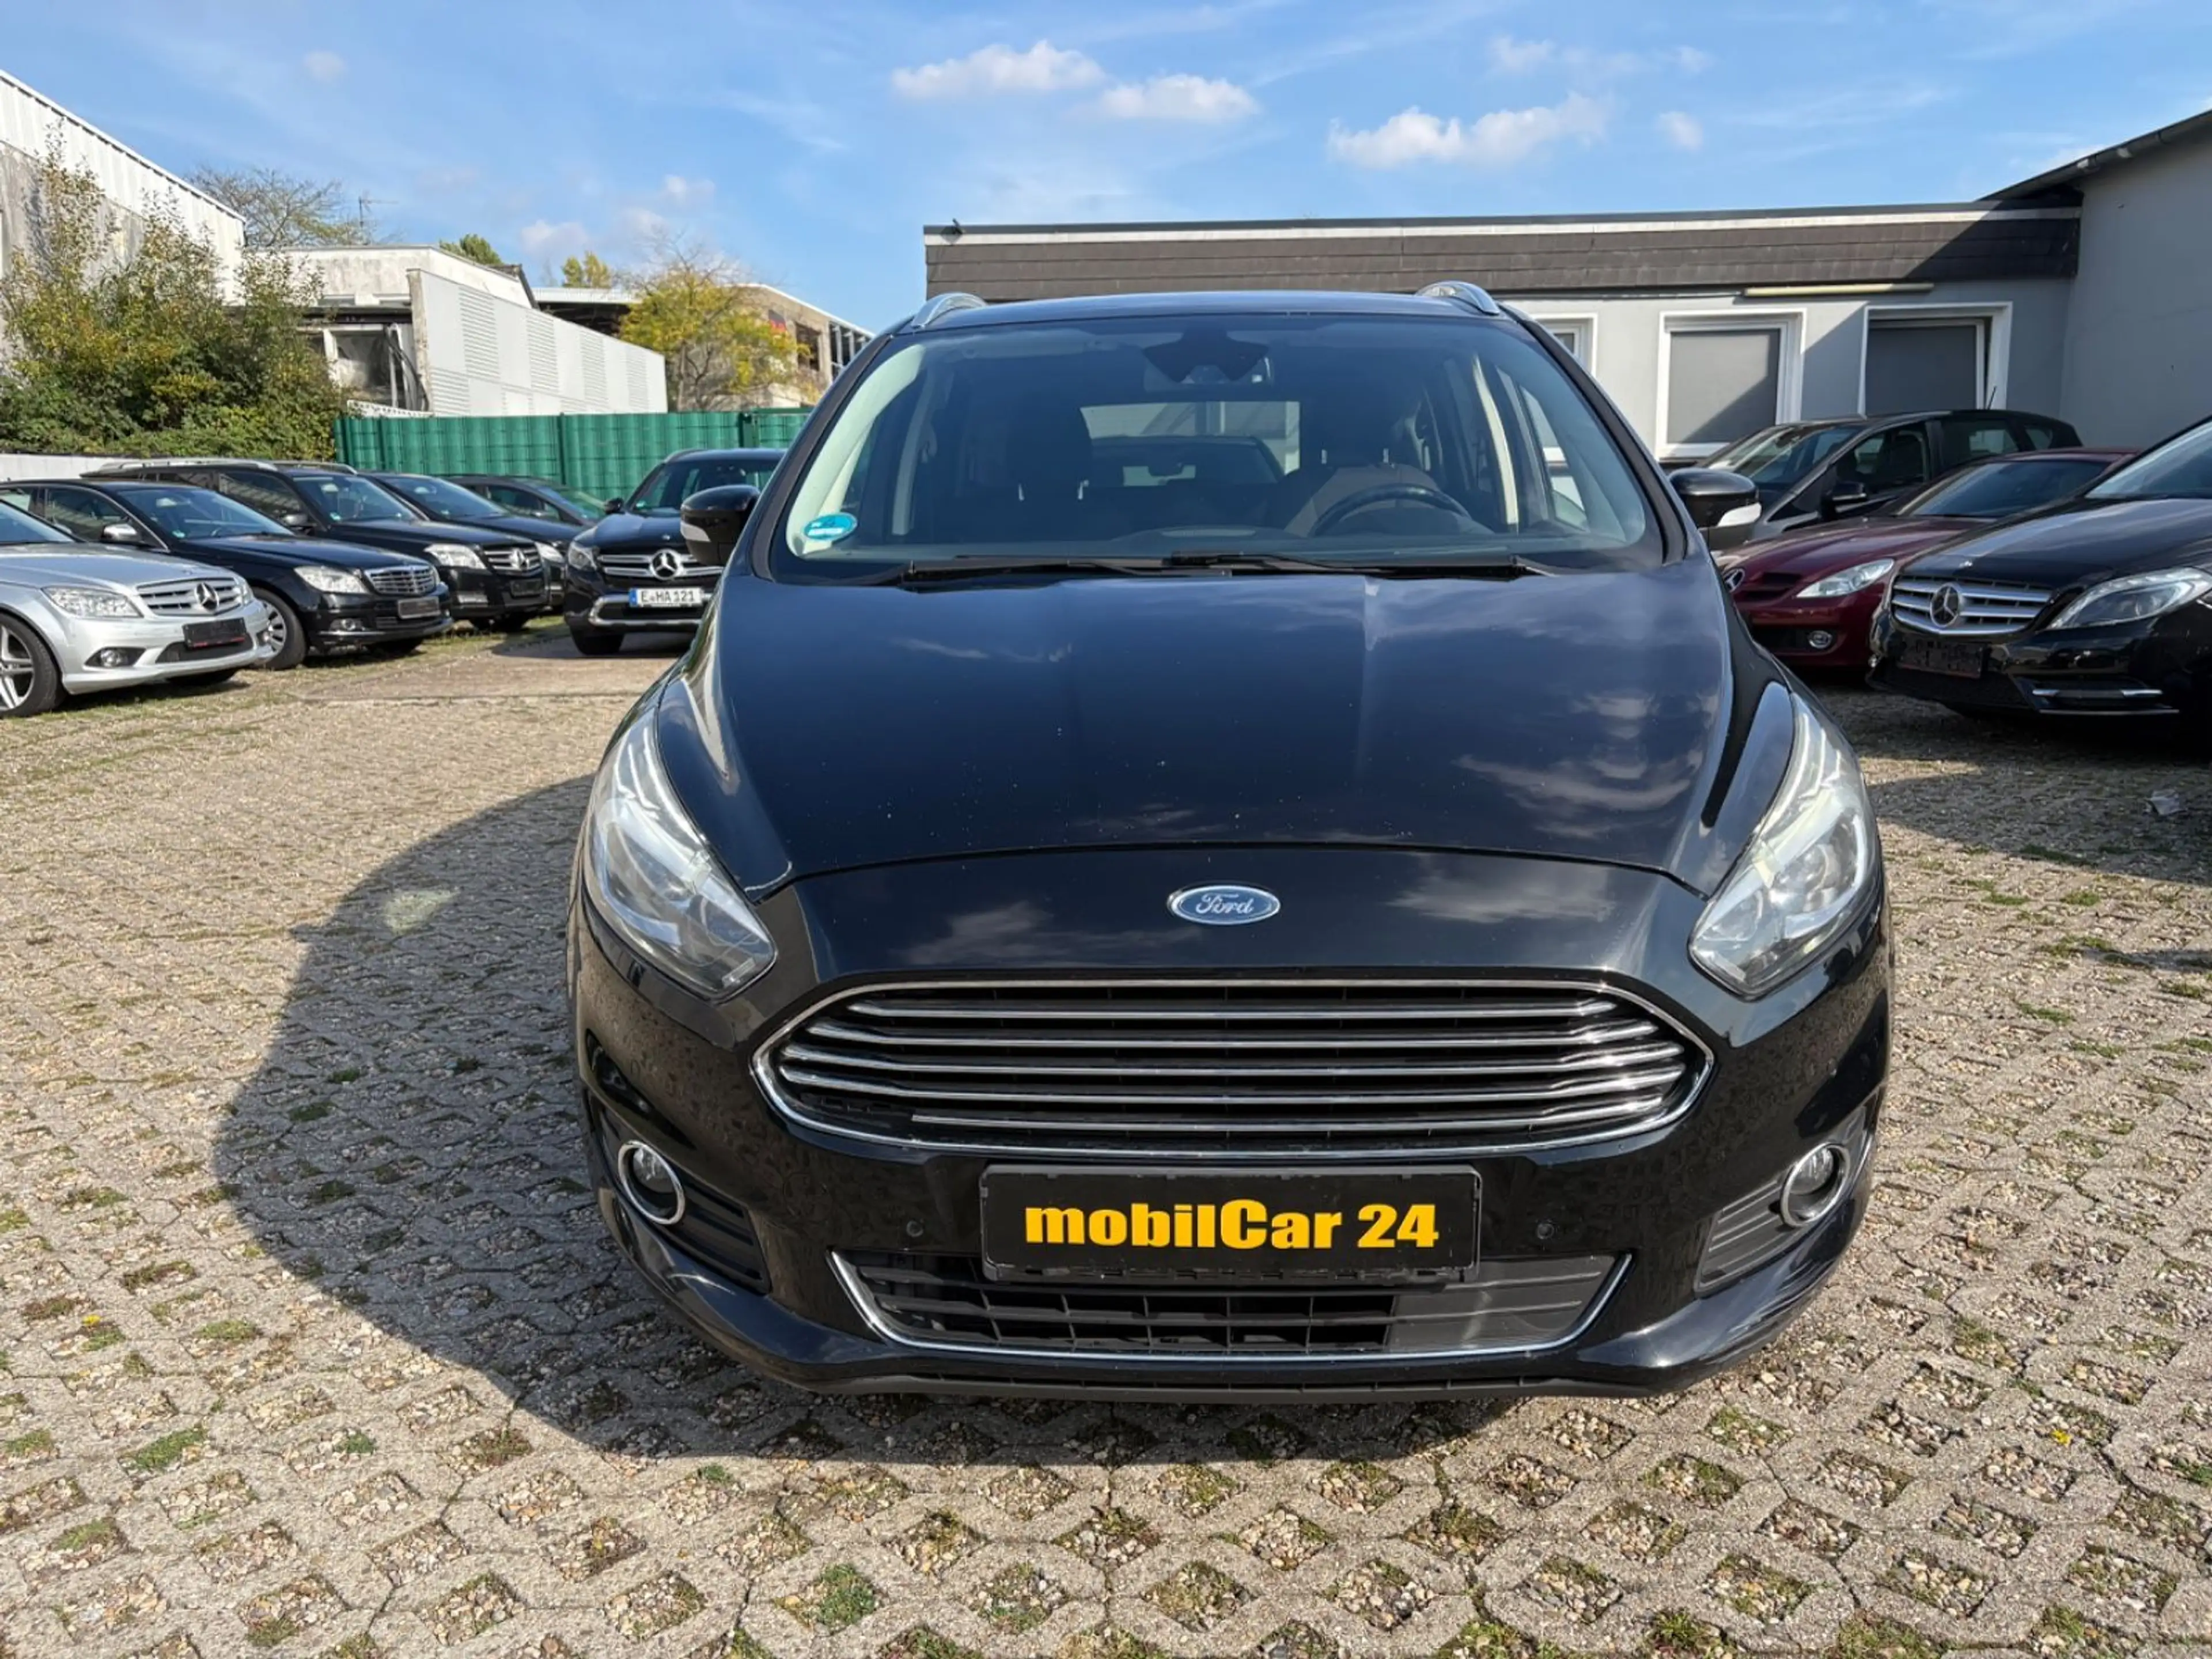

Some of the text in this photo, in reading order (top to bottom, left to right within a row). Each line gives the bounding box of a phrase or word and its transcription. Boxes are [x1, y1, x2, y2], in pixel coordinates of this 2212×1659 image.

[1195, 893, 1255, 914] Ford
[1025, 1199, 1440, 1249] mobilCar 24
